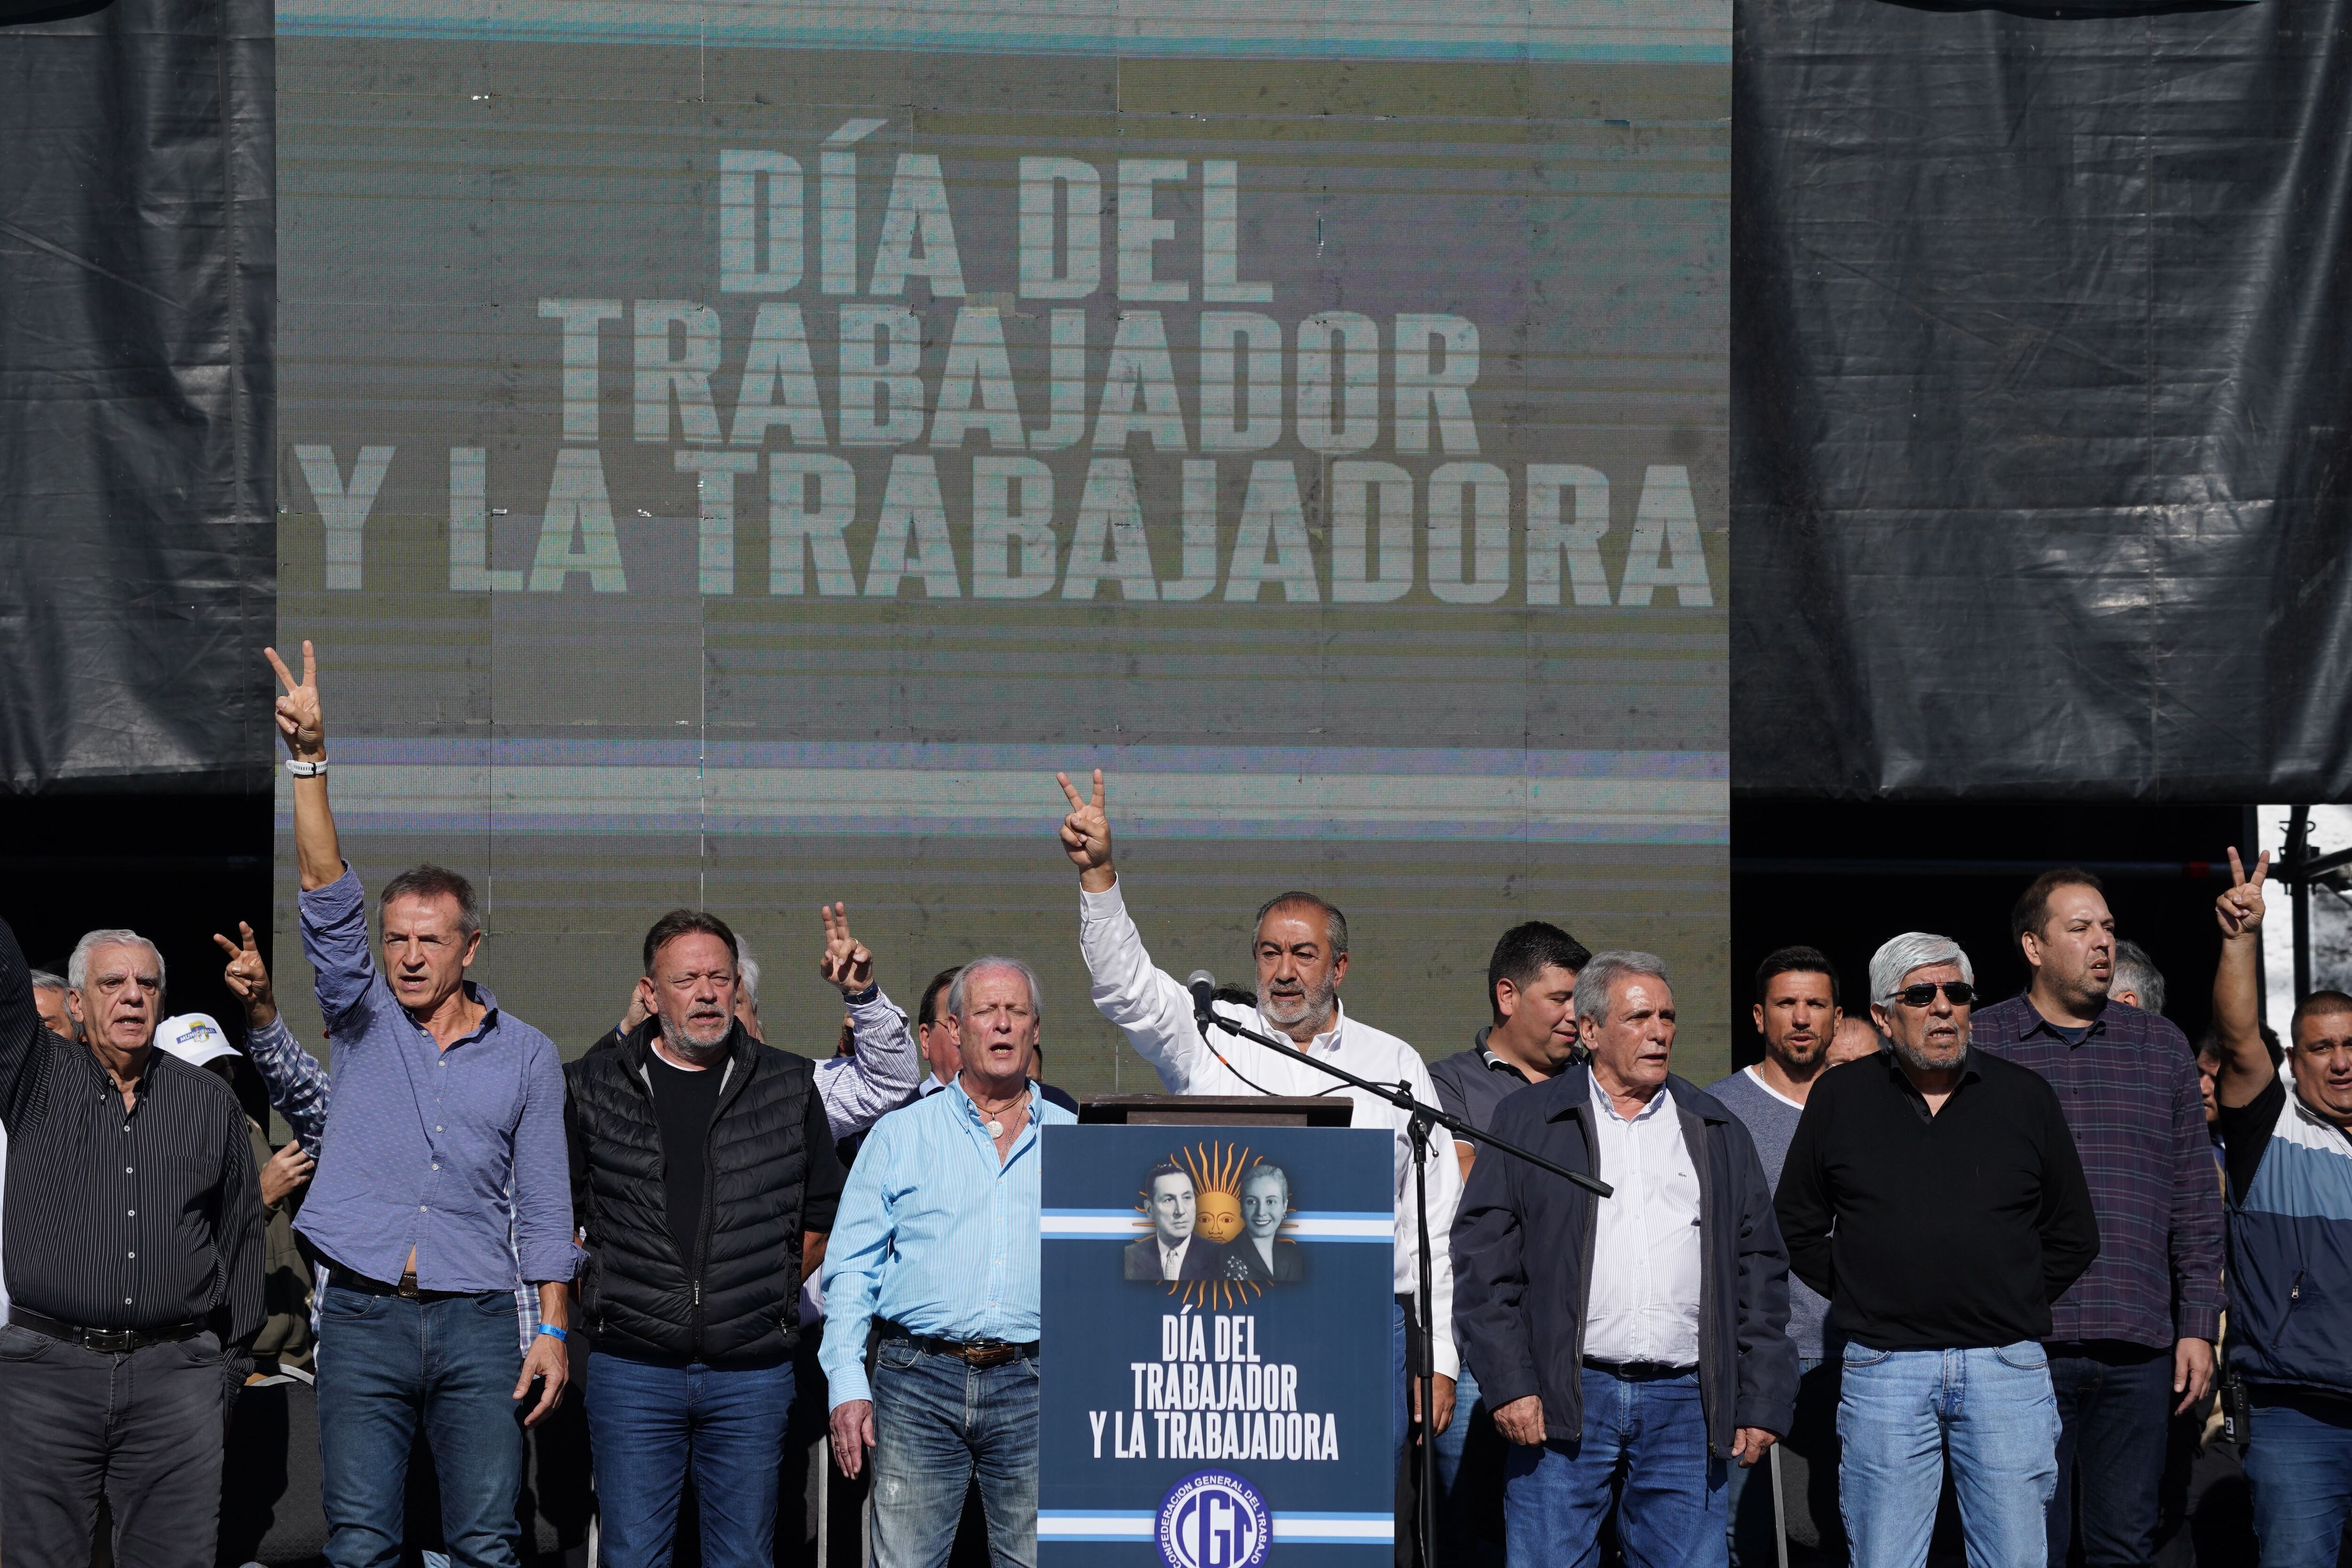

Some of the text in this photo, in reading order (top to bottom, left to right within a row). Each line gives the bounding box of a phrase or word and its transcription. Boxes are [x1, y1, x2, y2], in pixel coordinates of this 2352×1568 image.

[720, 119, 1274, 302] DÍA DEL
[538, 299, 1480, 455] TRABAJADOR
[294, 445, 1714, 606] Y LA TRABAJADORA
[1162, 1304, 1260, 1362] DÍA DEL
[1131, 1363, 1297, 1411] TRABAJADOR
[1089, 1411, 1339, 1460] Y LA TRABAJADORA
[2226, 1420, 2231, 1431] 2
[1160, 1475, 1267, 1568] CONFEDERACION GENERAL DEL TRABAJO
